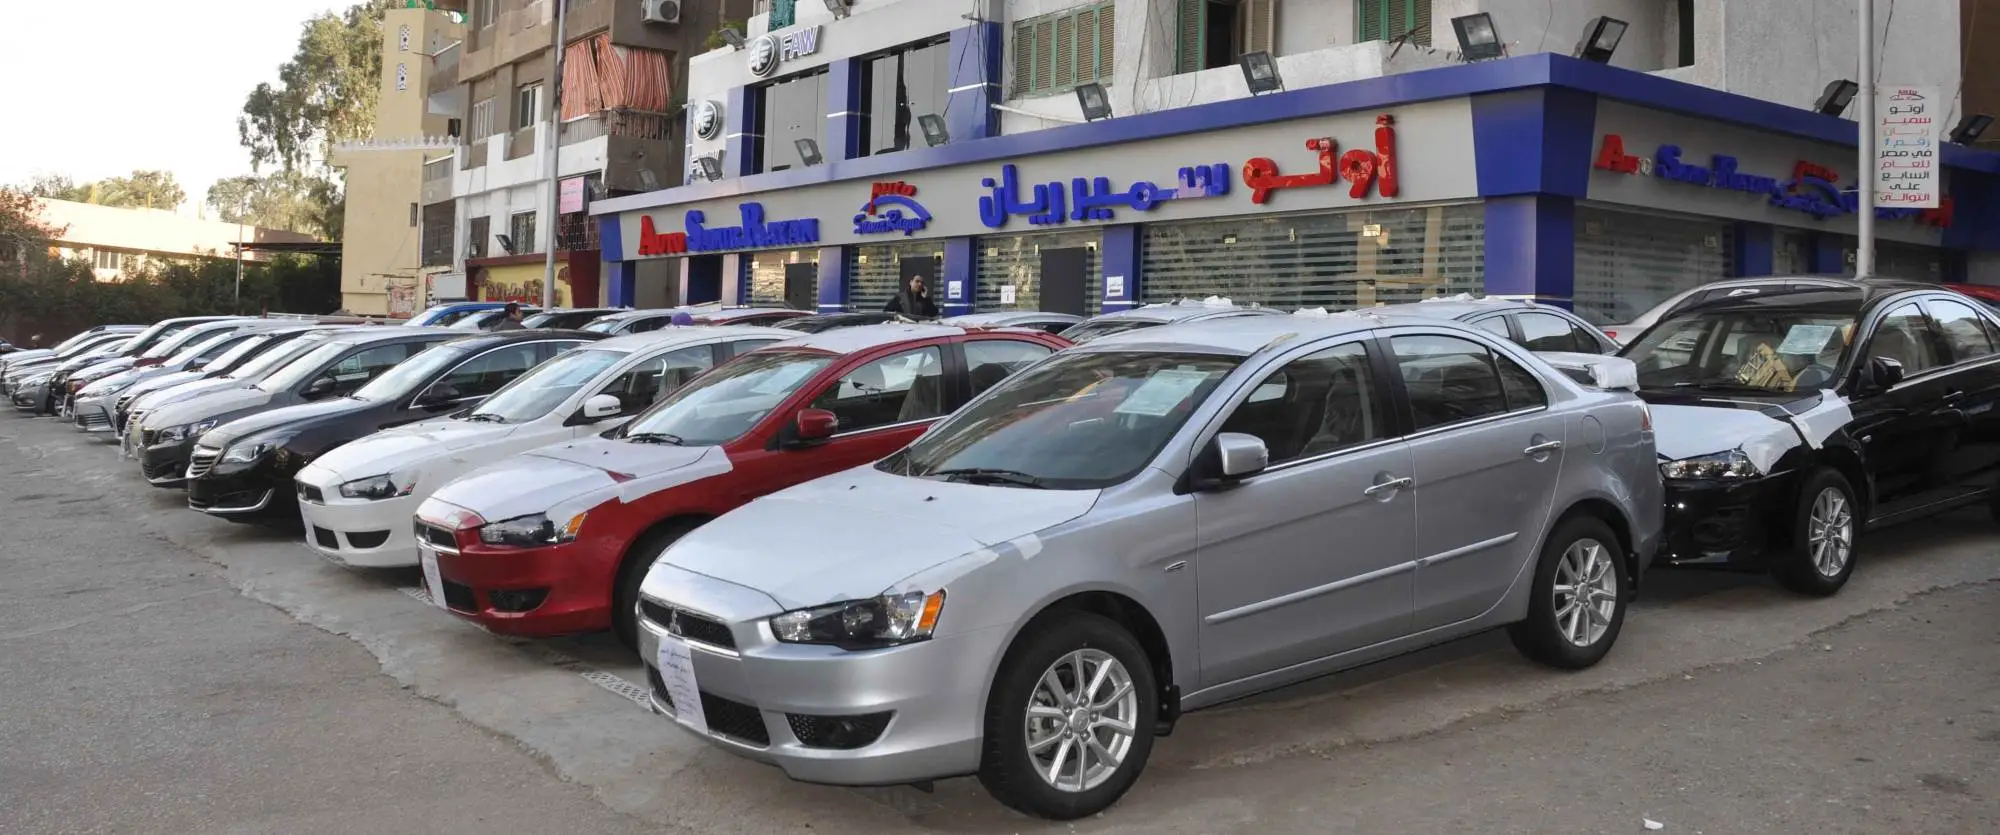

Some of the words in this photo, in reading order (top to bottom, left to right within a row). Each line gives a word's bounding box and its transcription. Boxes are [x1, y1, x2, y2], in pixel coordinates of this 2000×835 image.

[780, 24, 824, 62] FAW
[1243, 113, 1399, 204] أوتو
[1880, 150, 1908, 158] مصر
[979, 164, 1066, 228] ريان
[1071, 163, 1230, 221] سمير
[1889, 182, 1921, 190] على
